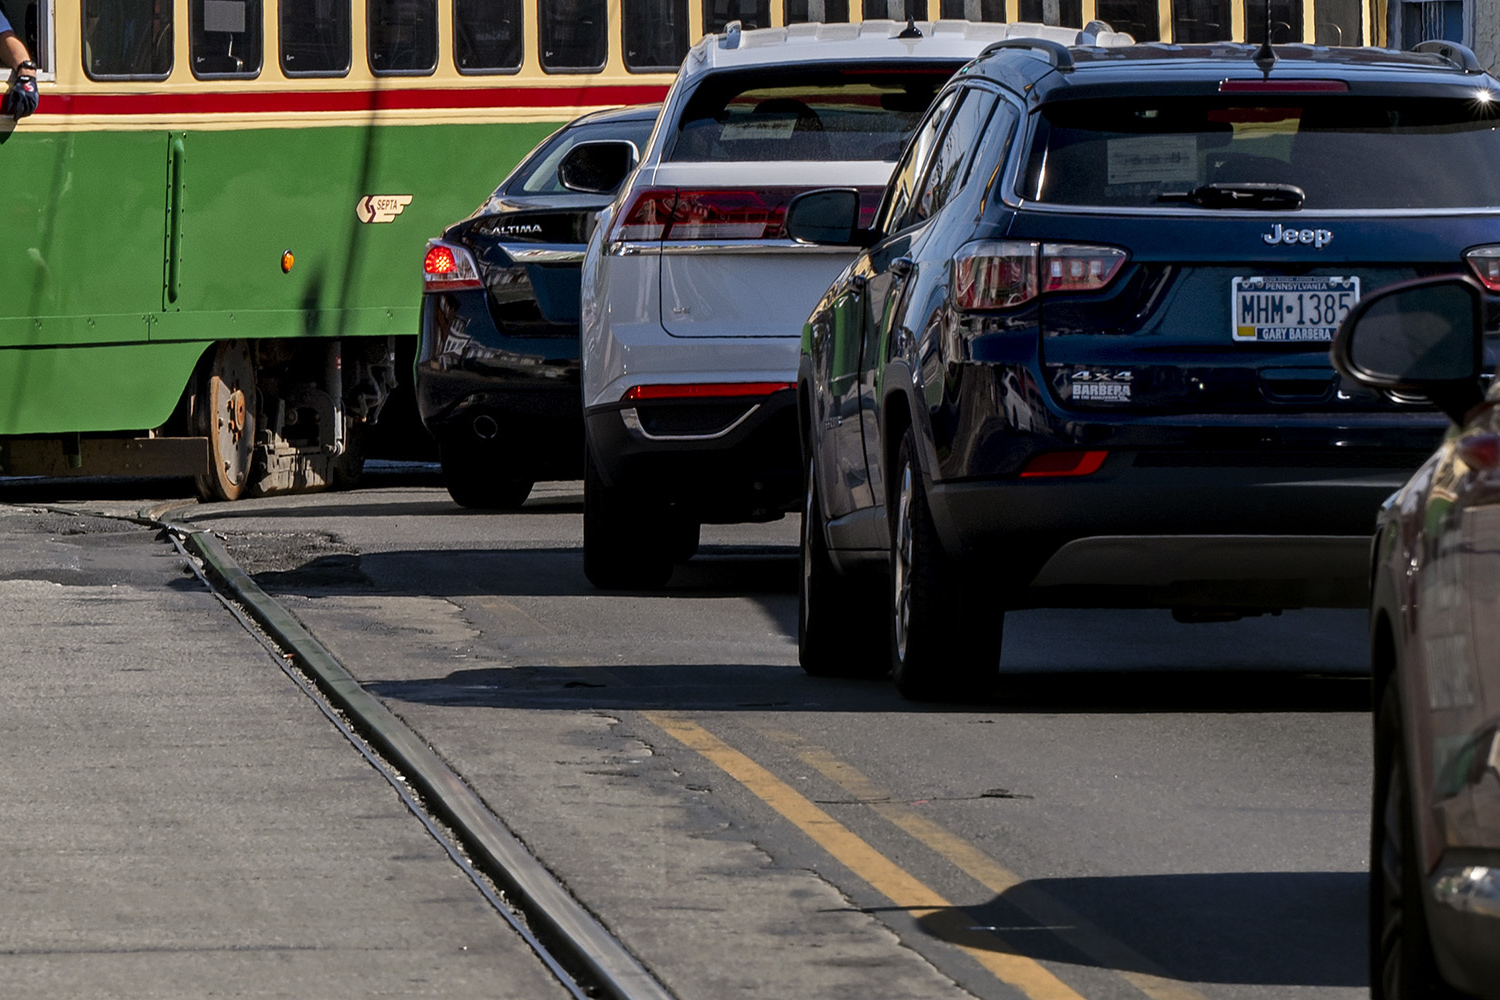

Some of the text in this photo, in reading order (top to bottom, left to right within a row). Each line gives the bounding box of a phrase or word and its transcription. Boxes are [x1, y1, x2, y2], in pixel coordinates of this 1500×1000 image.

[376, 199, 398, 211] SEPTA
[491, 223, 542, 235] ALTIMA
[1262, 223, 1334, 248] Jeep
[1265, 282, 1328, 291] PENNSYLVANIA
[1262, 328, 1332, 340] GARY BARBERA
[1071, 371, 1134, 381] 4x4
[1072, 384, 1132, 397] BARBERA
